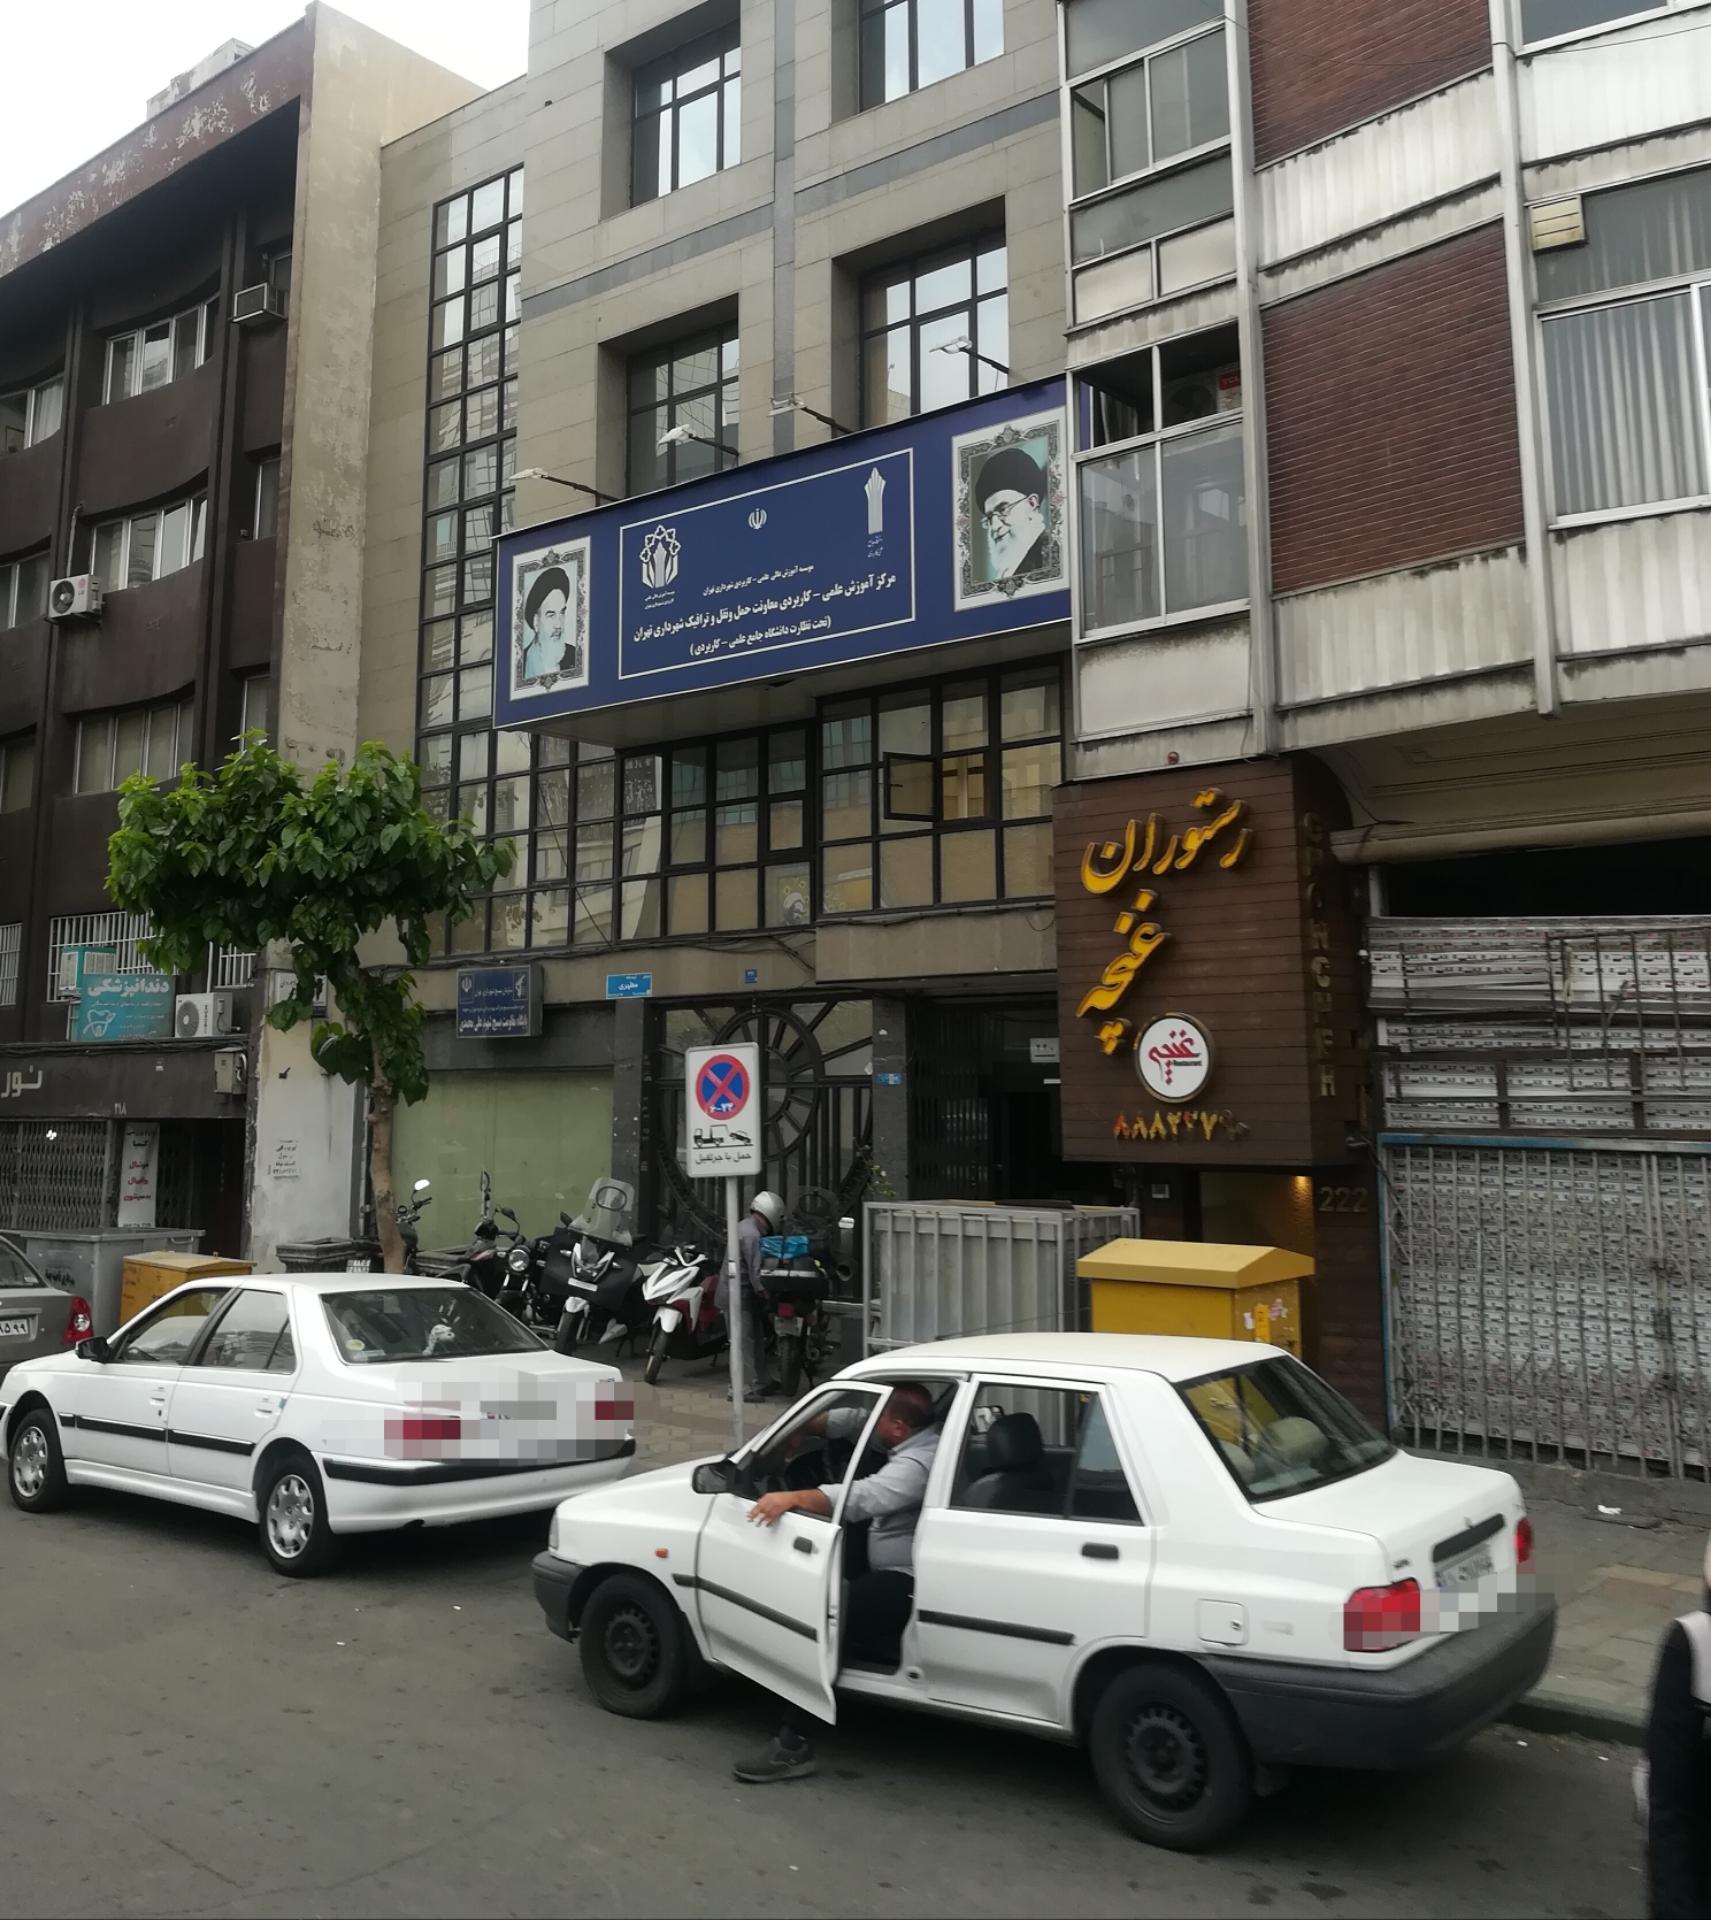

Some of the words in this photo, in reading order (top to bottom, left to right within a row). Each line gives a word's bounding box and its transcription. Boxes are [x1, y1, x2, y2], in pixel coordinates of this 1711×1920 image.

[757, 573, 769, 583] علمی
[782, 564, 799, 578] آموزش
[715, 581, 734, 594] شهرداری
[734, 576, 752, 589] کاربردی
[844, 573, 874, 597] آموزش
[875, 572, 896, 591] مرکز
[702, 585, 715, 597] تهران
[821, 583, 843, 602] علمی
[752, 598, 779, 615] معاونت
[779, 589, 812, 611] کاربردی
[685, 611, 710, 629] ترافیک
[733, 604, 752, 621] حمل
[633, 624, 653, 642] تهران
[653, 618, 685, 638] شهرداری
[764, 624, 789, 639] دانشگاه
[788, 618, 812, 636] نظارت
[728, 633, 746, 649] علمی
[746, 629, 764, 646] جامع
[1080, 787, 1254, 896] رستوران
[1076, 888, 1174, 1057] غنچه
[87, 977, 170, 998] دندانپزشکی
[617, 981, 638, 991] مطهری
[0, 1065, 43, 1098] نور
[695, 1153, 723, 1165] جرثقیل
[725, 1151, 732, 1161] با
[733, 1151, 752, 1163] حمل
[1319, 1186, 1368, 1213] 222
